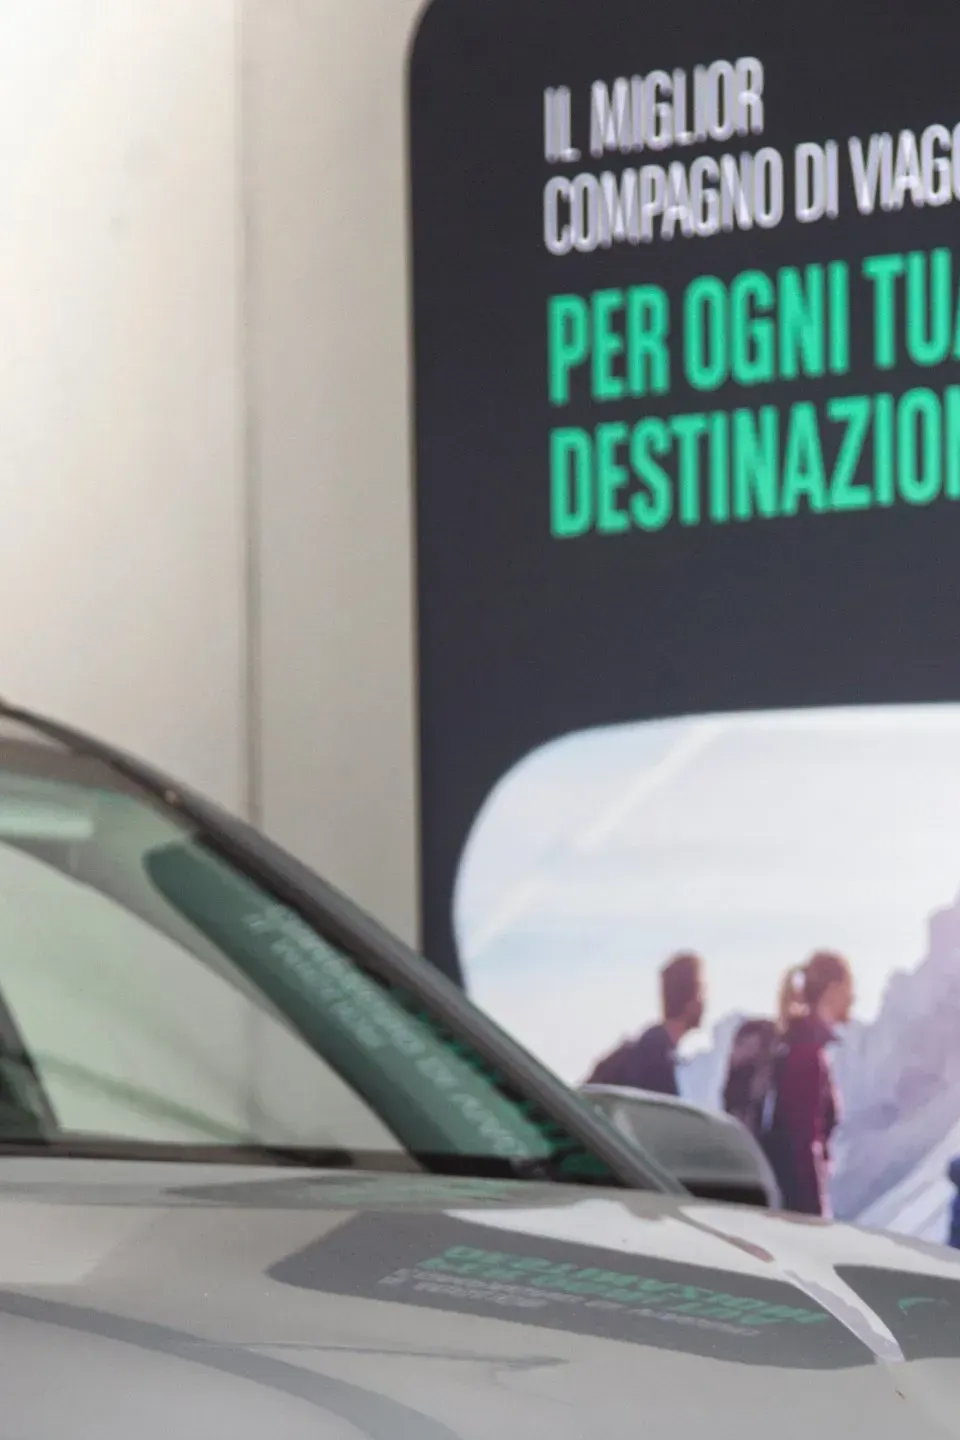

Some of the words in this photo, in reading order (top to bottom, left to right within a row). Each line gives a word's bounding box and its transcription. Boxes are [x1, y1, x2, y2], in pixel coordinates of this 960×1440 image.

[543, 85, 581, 163] IL
[589, 56, 764, 154] MIGLIOR
[543, 146, 785, 256] COMPAGNO
[794, 139, 840, 224] DI
[547, 284, 670, 406] PER
[683, 259, 850, 392] OGNI
